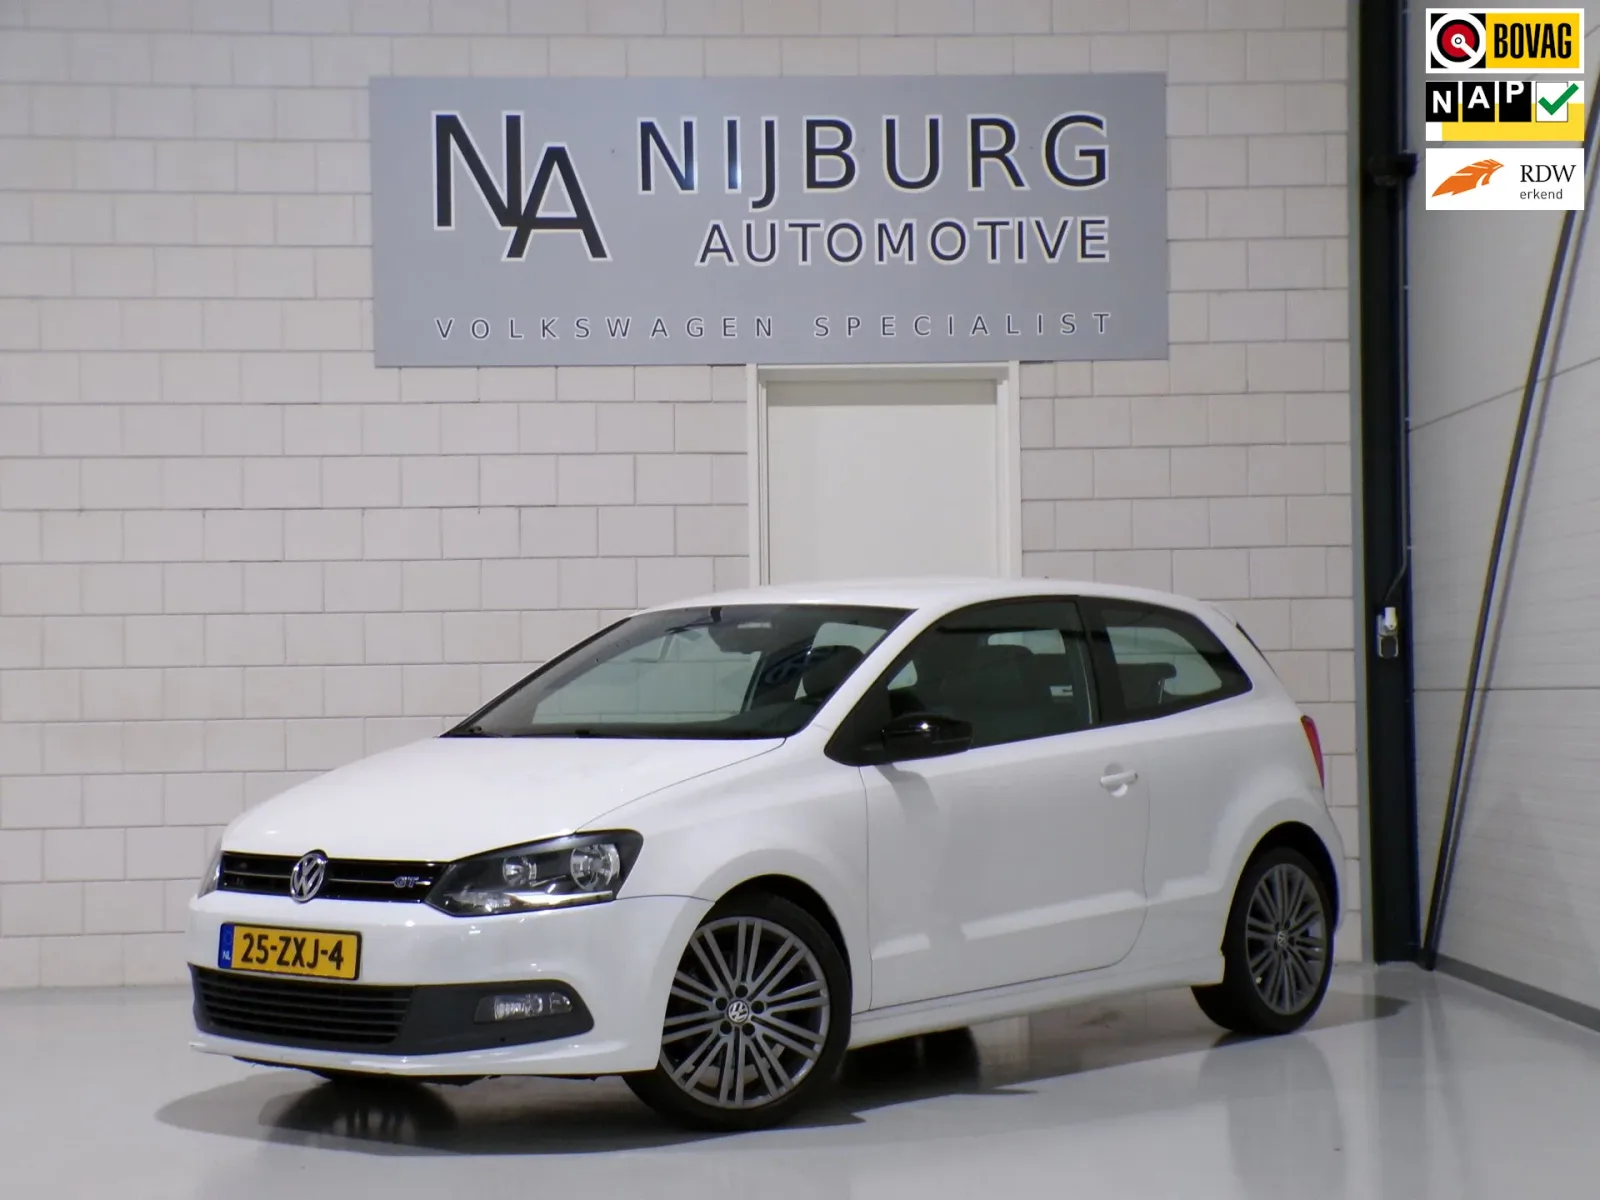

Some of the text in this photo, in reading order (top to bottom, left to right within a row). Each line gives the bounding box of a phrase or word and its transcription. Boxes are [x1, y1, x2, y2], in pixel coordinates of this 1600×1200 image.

[638, 112, 1108, 210] NIJBURG
[696, 218, 1108, 265] AUTOMOTIVE
[435, 313, 1110, 339] VOLKSWAGEN SPECIALIST
[393, 876, 419, 888] GT
[222, 950, 231, 960] NL
[240, 932, 344, 971] 25-ZXJ-4
